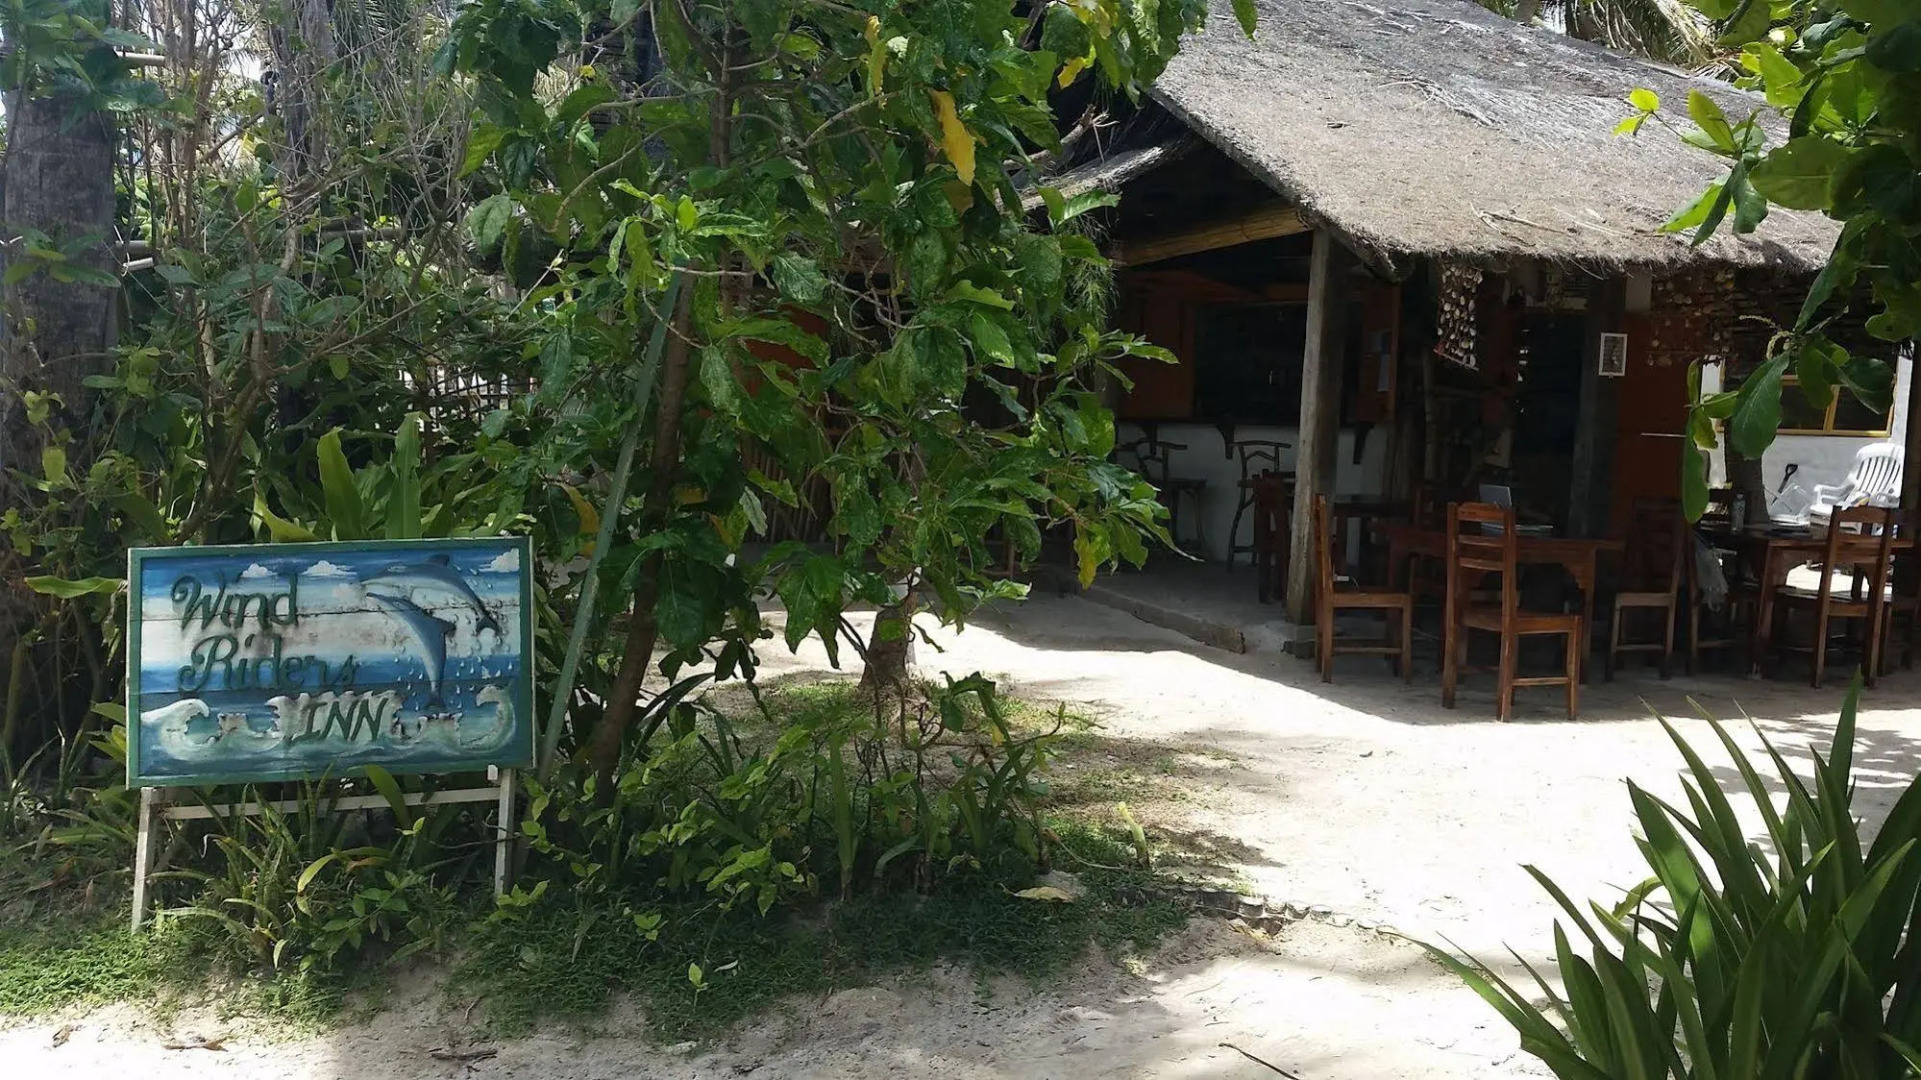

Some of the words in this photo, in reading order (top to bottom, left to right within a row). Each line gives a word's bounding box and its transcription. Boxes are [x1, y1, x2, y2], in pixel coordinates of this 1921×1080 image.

[171, 570, 298, 630] Wind
[178, 634, 358, 692] Riders
[299, 697, 388, 741] INN
